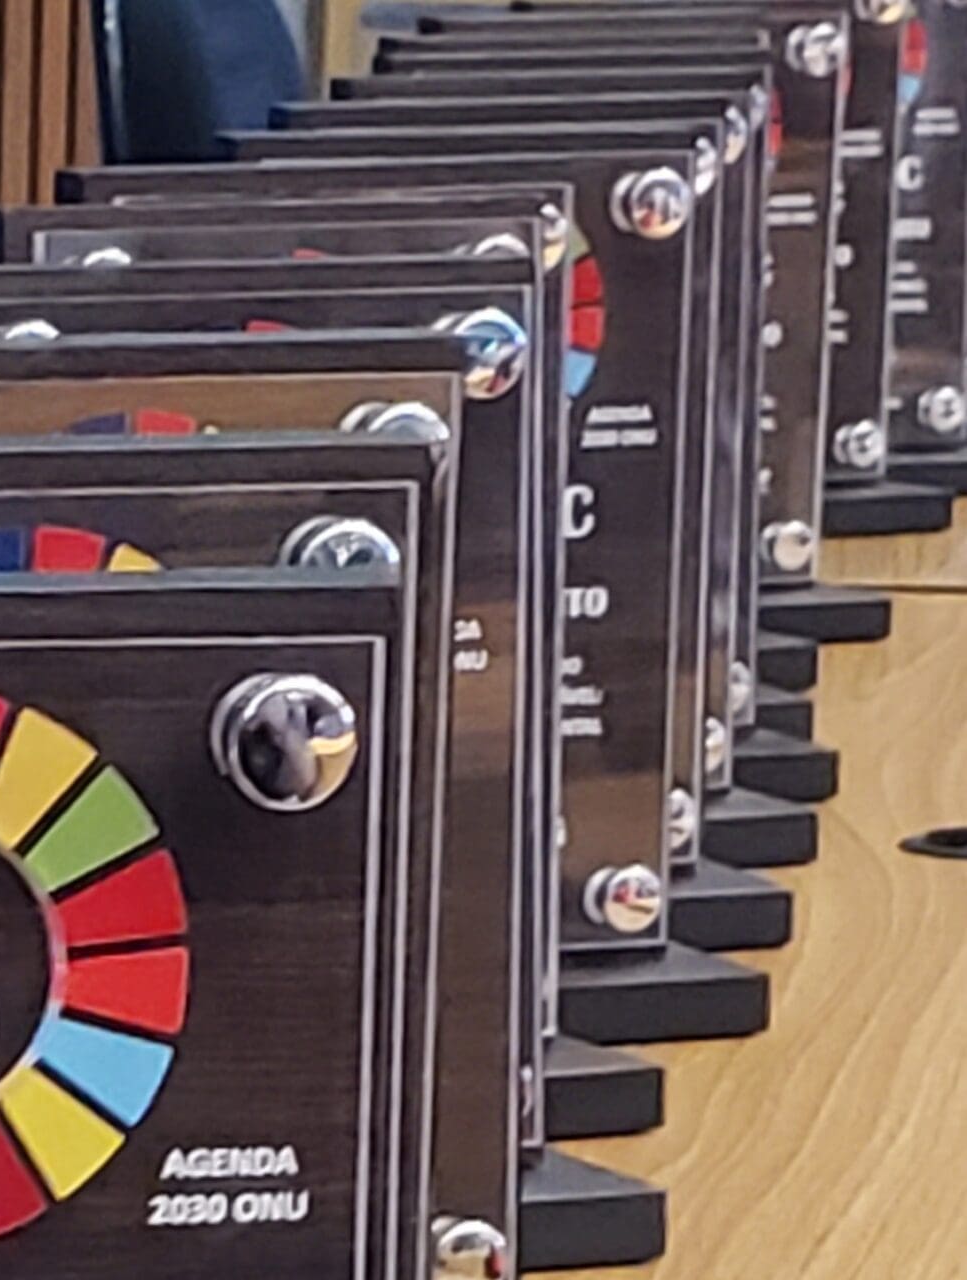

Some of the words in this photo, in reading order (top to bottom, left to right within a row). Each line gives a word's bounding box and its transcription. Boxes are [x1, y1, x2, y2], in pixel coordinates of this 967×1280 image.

[160, 1145, 299, 1180] AGENDA
[147, 1192, 227, 1226] 2030
[232, 1189, 310, 1223] ONU
